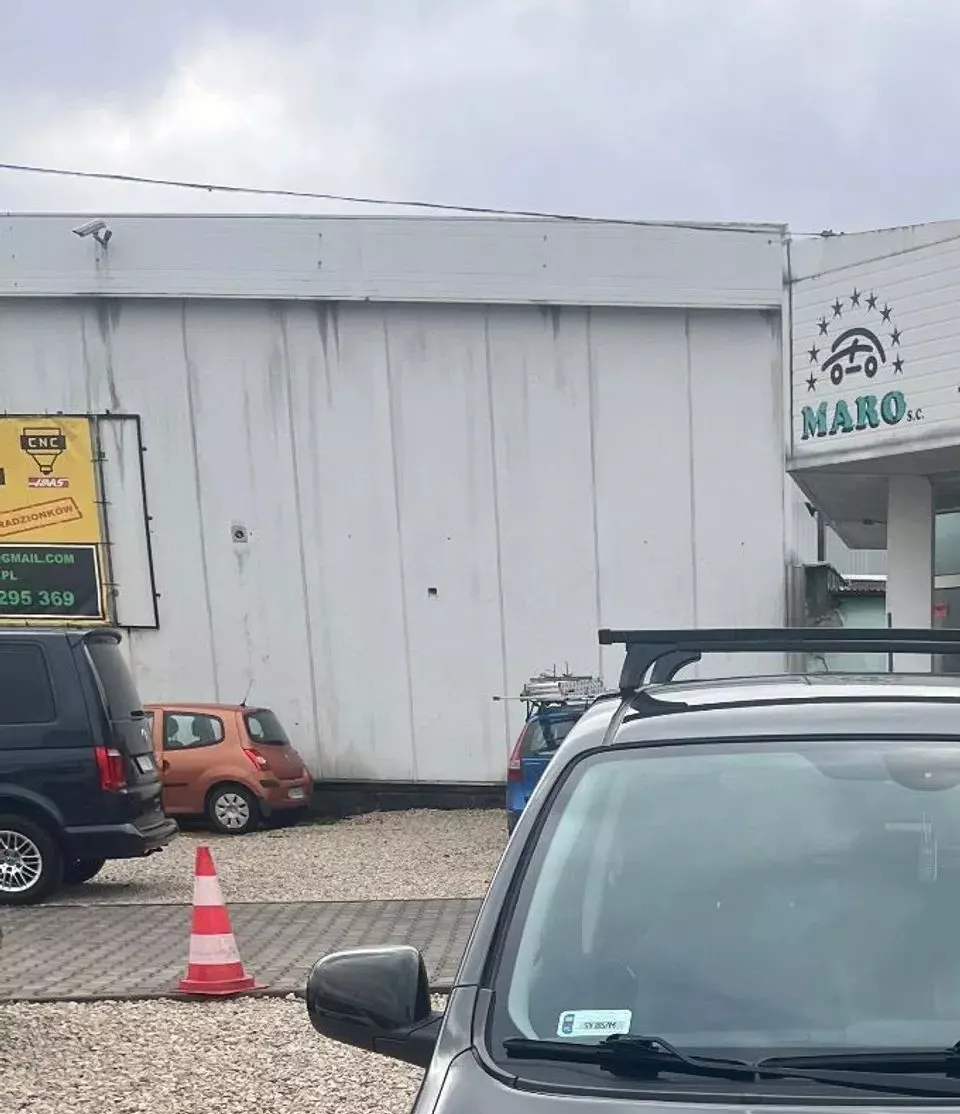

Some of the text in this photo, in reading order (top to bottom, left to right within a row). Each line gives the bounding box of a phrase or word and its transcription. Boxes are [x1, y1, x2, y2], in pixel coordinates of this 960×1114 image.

[801, 390, 907, 440] MARO
[28, 437, 58, 448] CNC
[38, 590, 75, 606] 369
